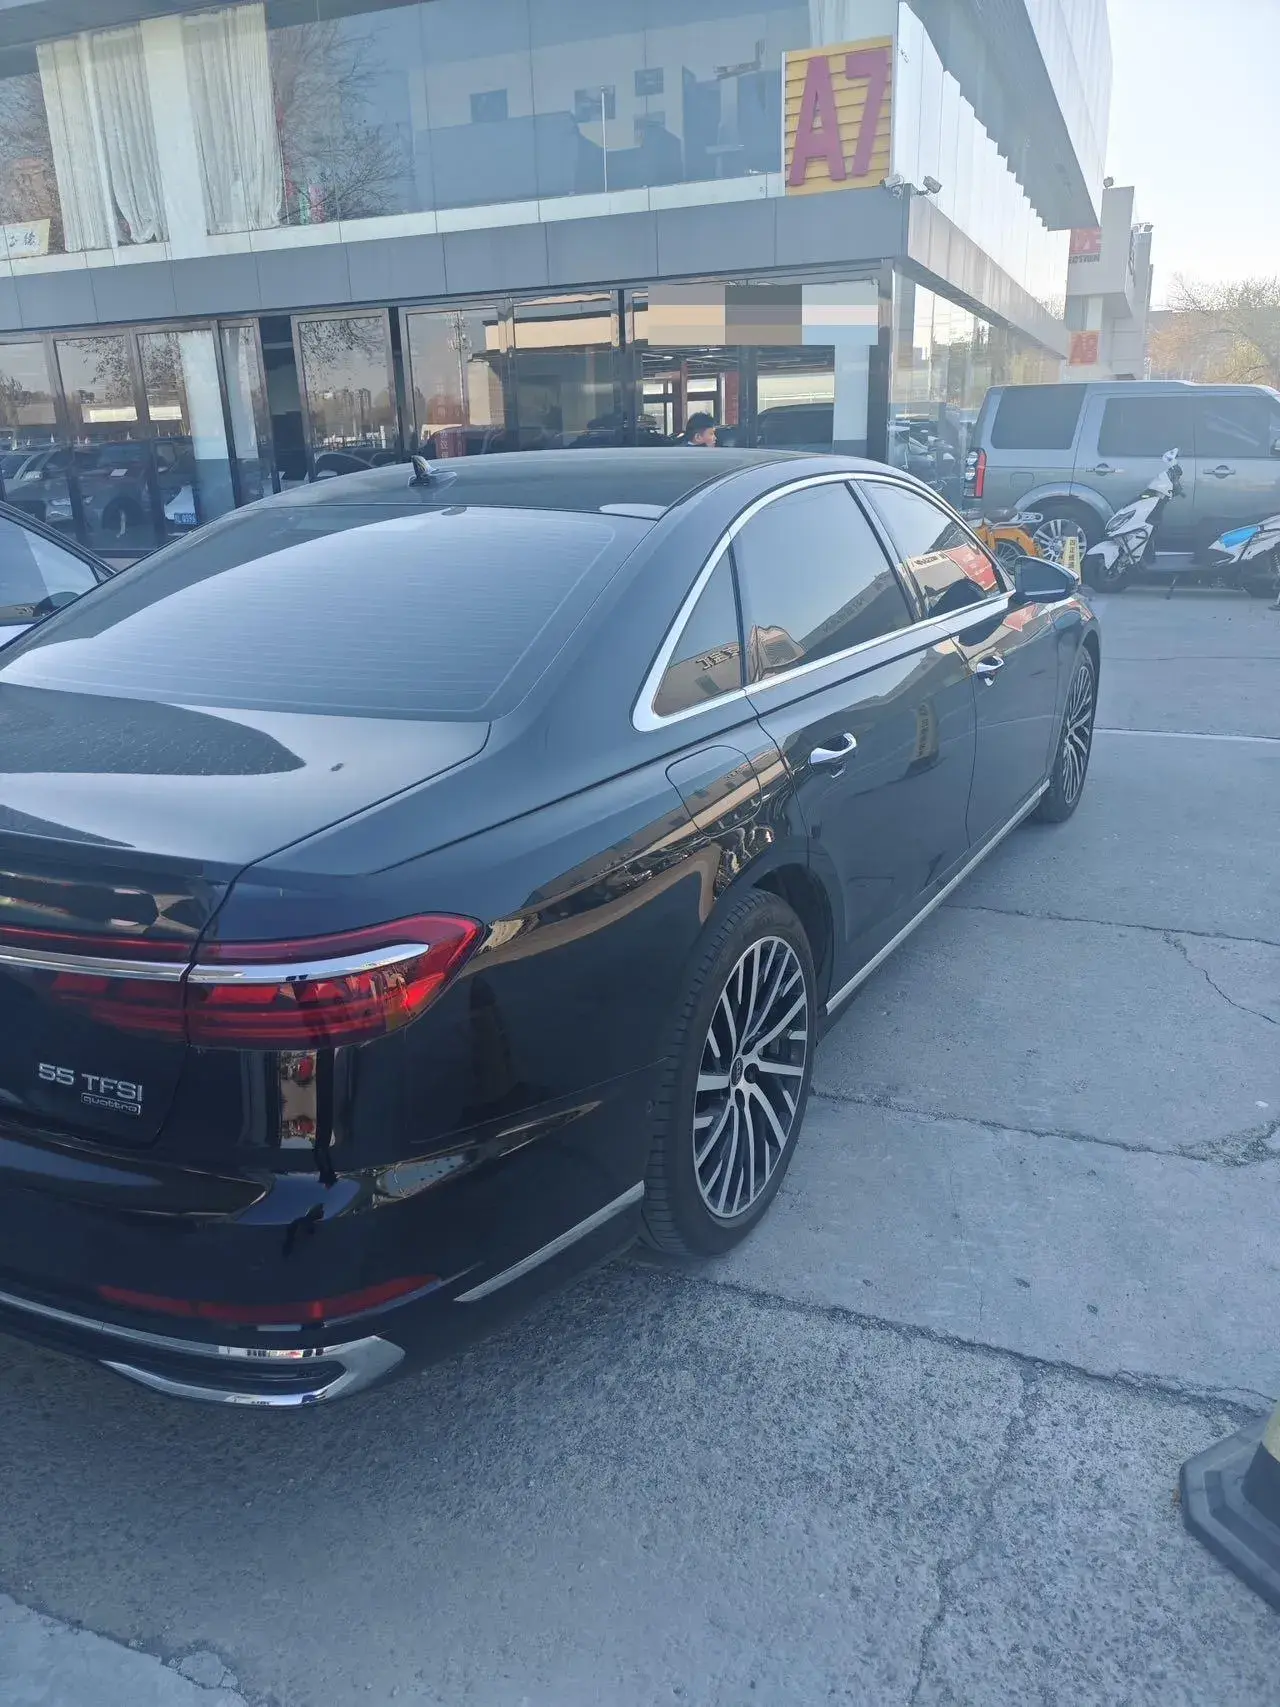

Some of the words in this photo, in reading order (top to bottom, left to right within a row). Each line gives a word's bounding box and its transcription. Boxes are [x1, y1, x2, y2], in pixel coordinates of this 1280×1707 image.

[789, 49, 888, 187] A7
[38, 1062, 75, 1086] 55
[81, 1073, 143, 1102] TFSI
[82, 1095, 139, 1113] quattro
